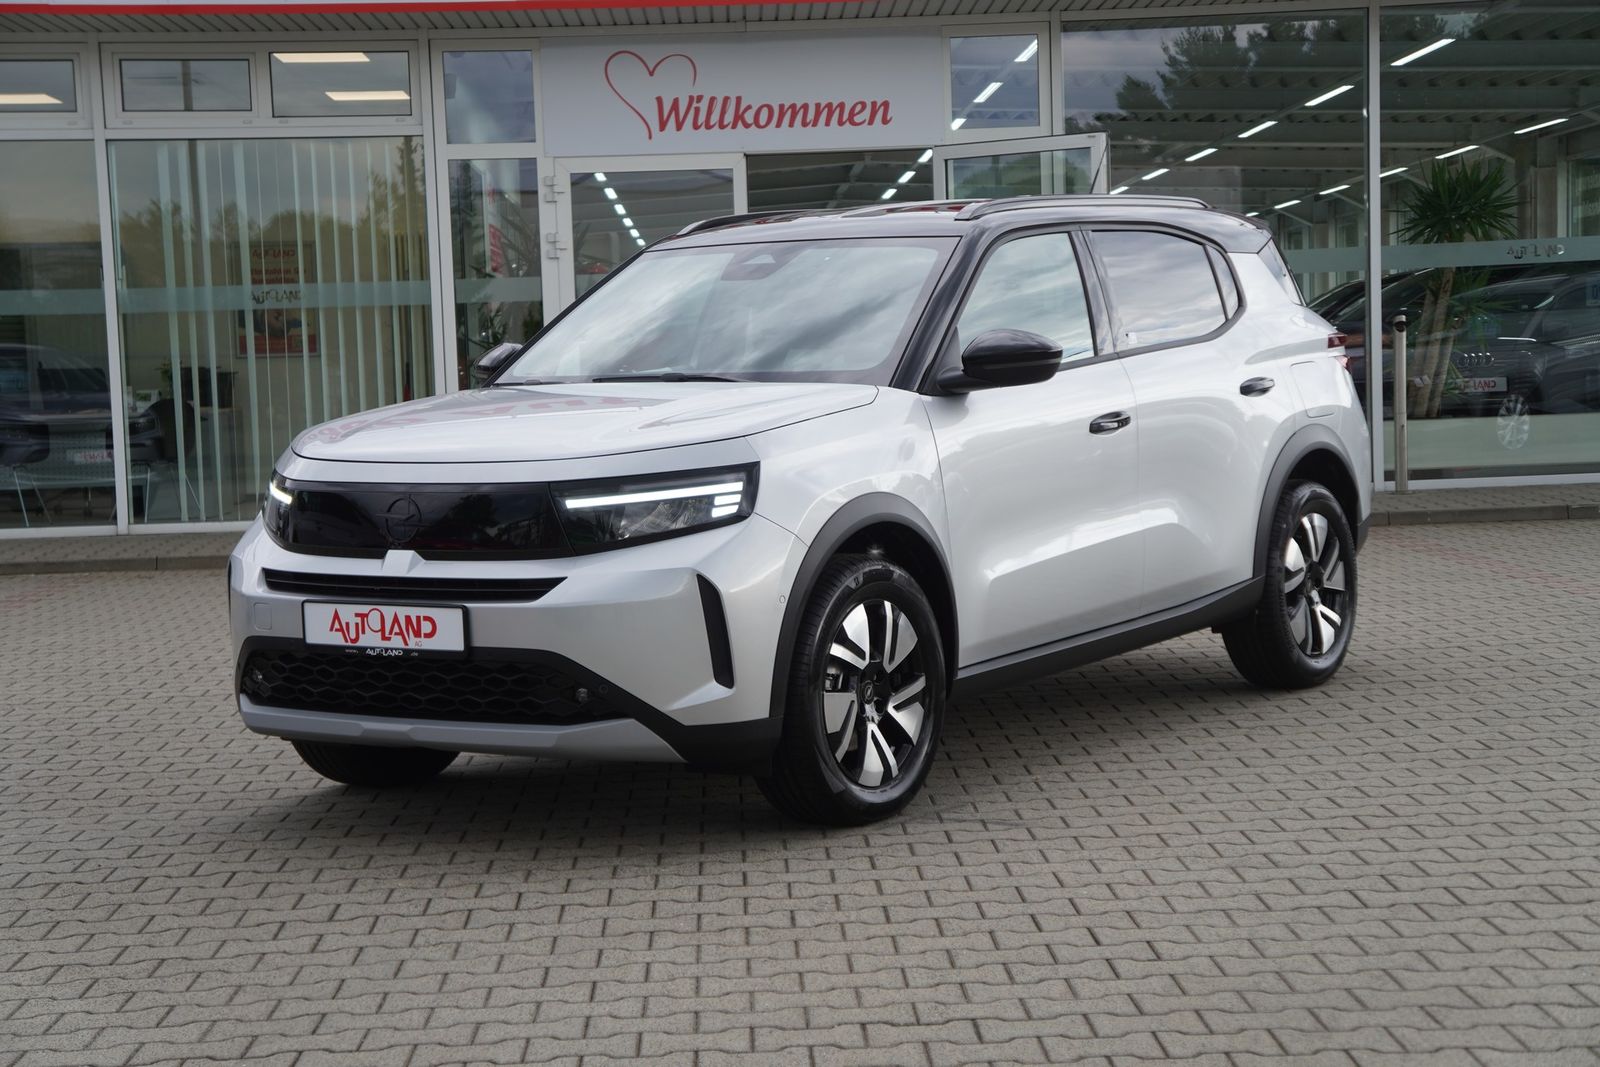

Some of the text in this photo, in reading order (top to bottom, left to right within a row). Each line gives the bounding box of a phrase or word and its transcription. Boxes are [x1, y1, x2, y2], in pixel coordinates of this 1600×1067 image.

[655, 94, 893, 132] Willkommen
[329, 607, 438, 647] AUTOLAND
[365, 647, 404, 657] AUTOLAND
